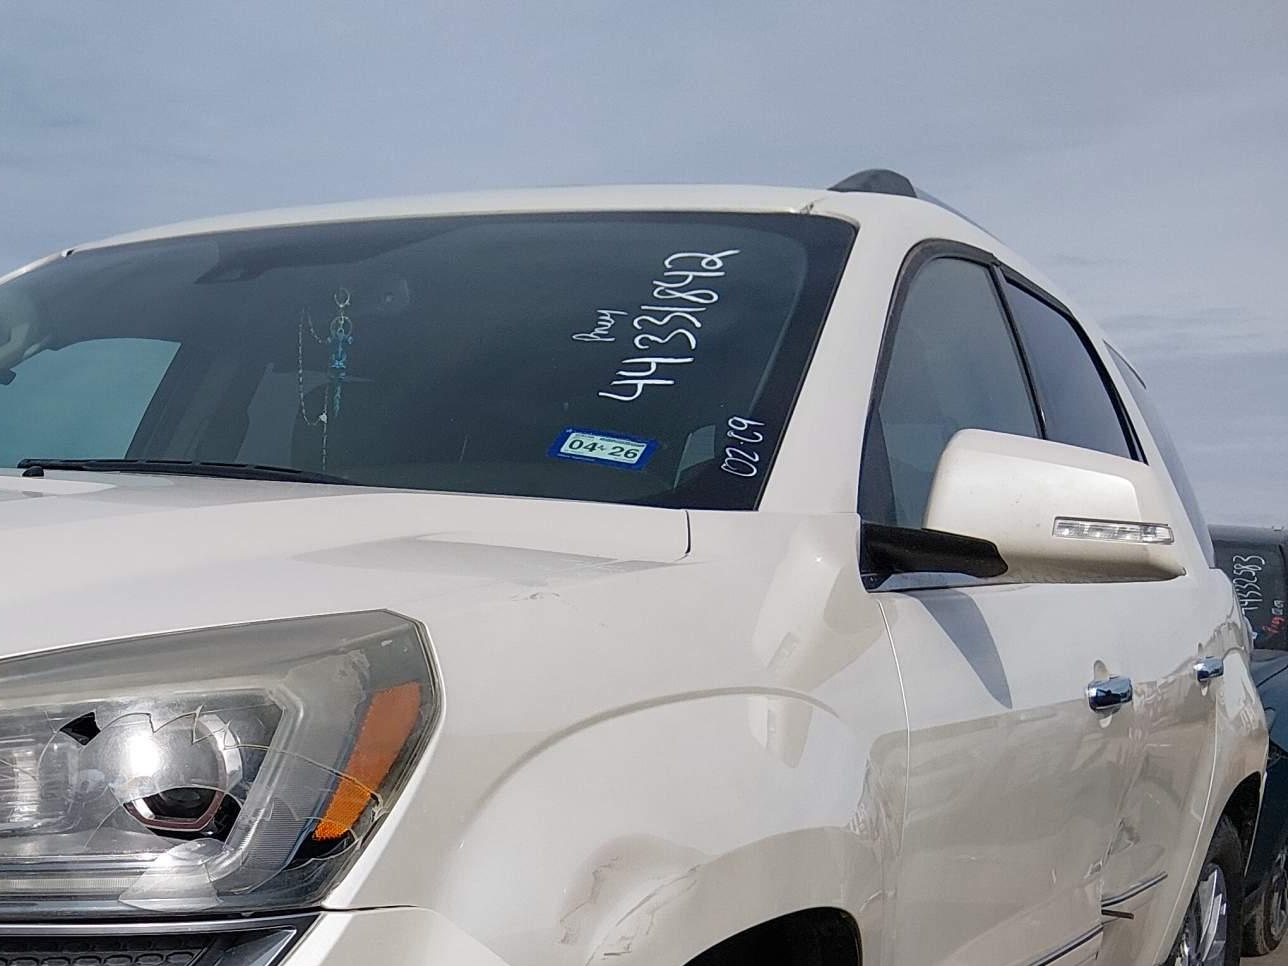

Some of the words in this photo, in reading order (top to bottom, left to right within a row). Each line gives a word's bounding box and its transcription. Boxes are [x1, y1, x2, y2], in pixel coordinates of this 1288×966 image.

[597, 249, 741, 402] 44331842
[568, 439, 598, 453] 04
[608, 446, 640, 459] 26
